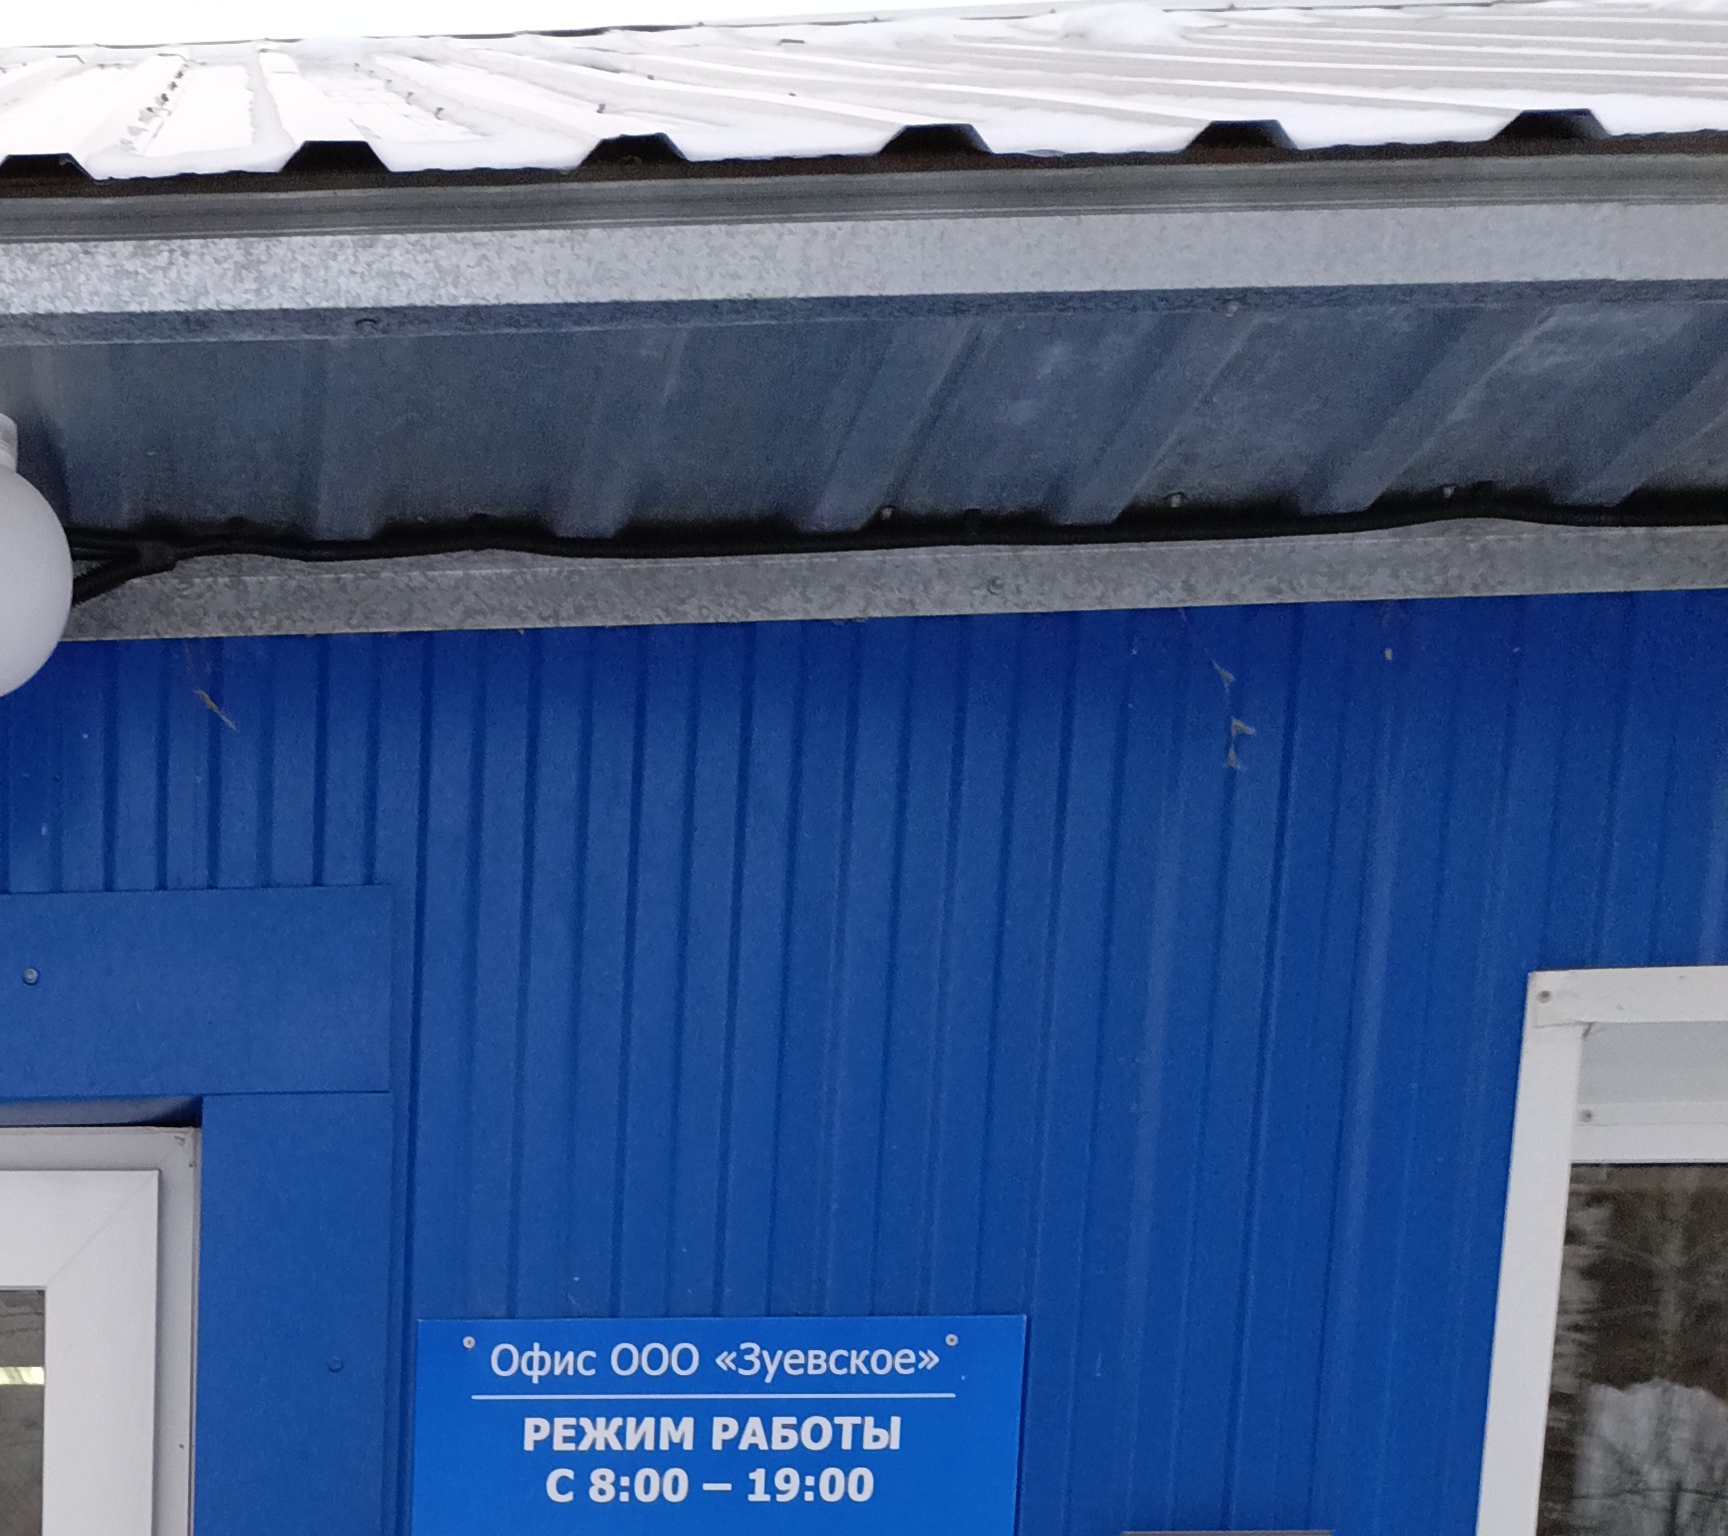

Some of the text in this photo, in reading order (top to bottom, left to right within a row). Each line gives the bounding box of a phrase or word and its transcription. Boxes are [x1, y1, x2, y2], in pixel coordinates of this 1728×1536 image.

[491, 1342, 940, 1384] Офис ООО «Зуевское»
[523, 1416, 901, 1451] РЕЖИМ РАБОТЫ
[546, 1468, 574, 1503] С
[589, 1468, 689, 1503] 8:00
[747, 1467, 874, 1502] 19:00
